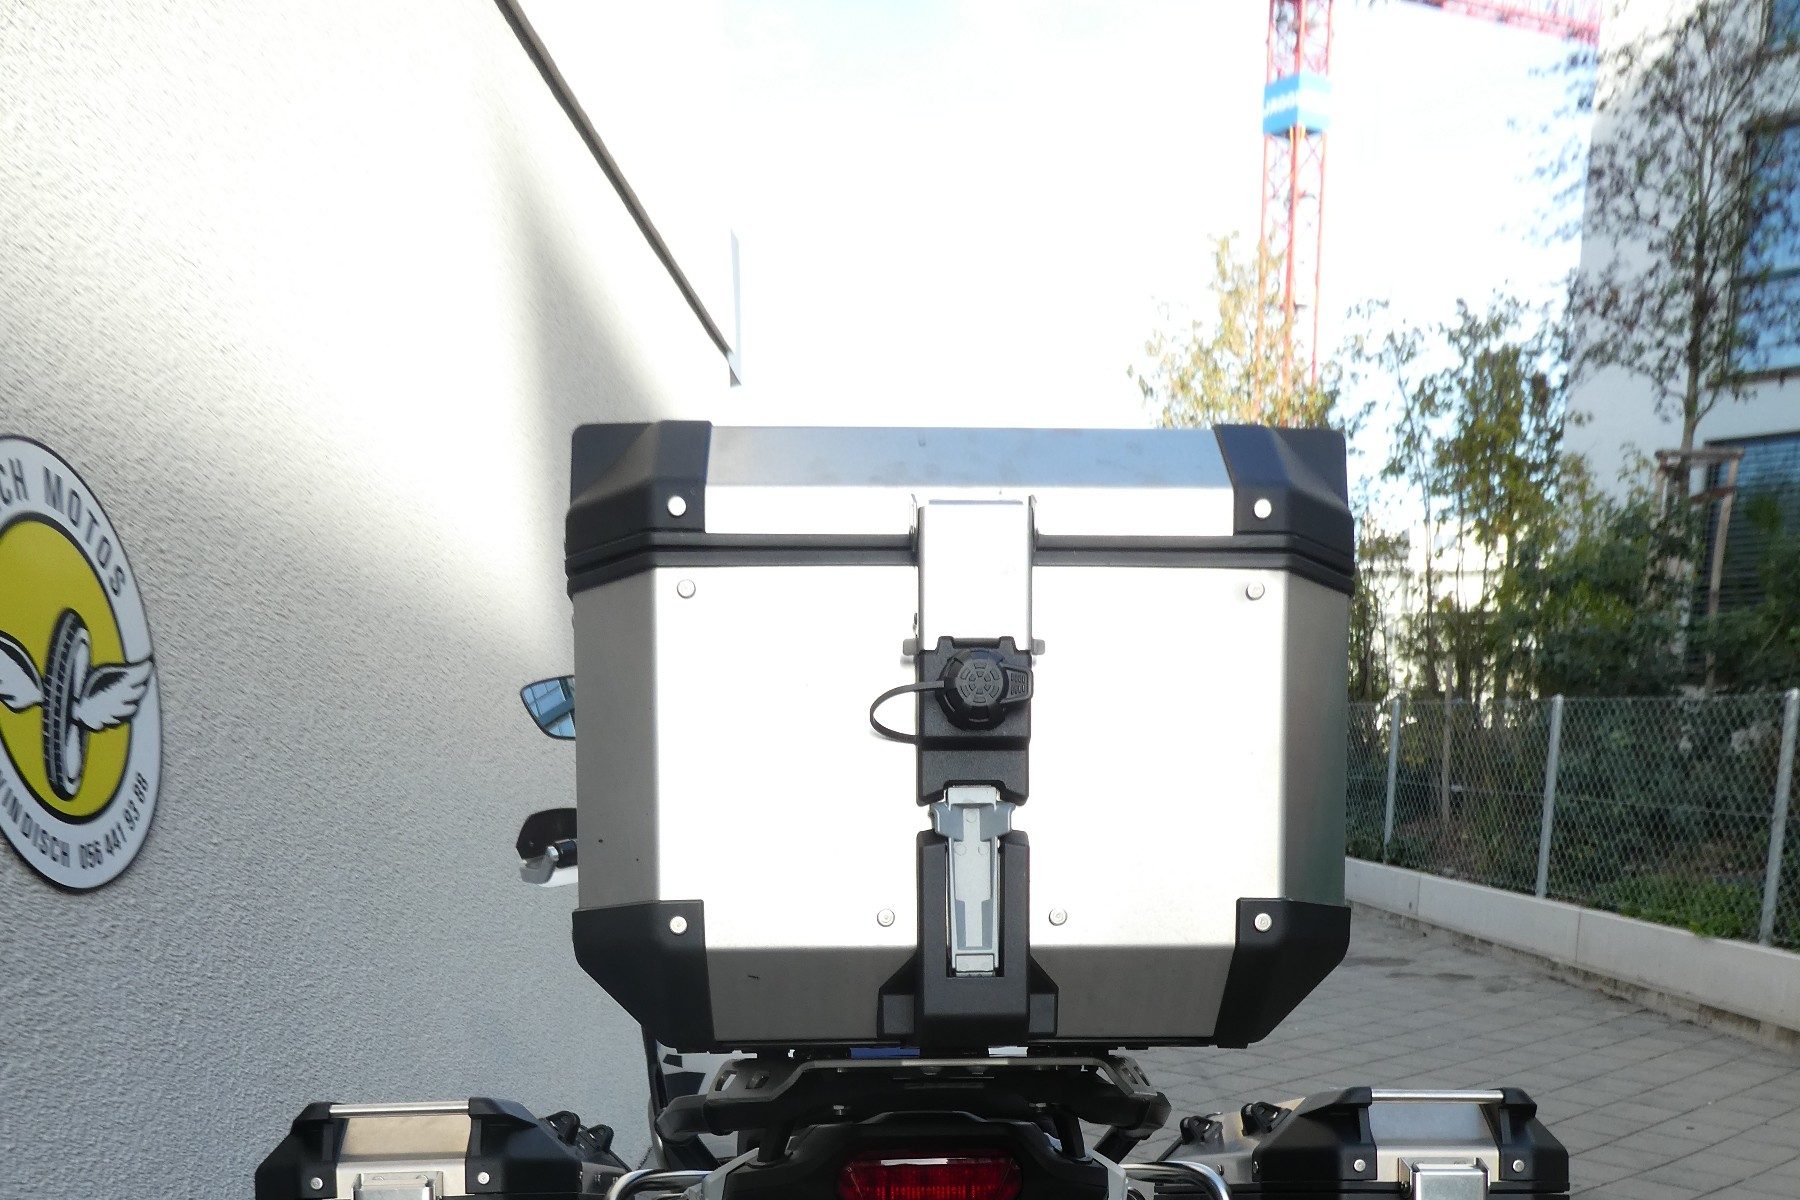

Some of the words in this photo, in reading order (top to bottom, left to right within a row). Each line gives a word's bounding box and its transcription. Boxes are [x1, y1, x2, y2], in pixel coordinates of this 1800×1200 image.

[43, 465, 126, 597] MOTOS
[0, 768, 70, 868] INDISCH
[79, 840, 104, 870] 056
[104, 822, 127, 856] 441
[123, 799, 140, 832] 93
[133, 771, 149, 804] 88
